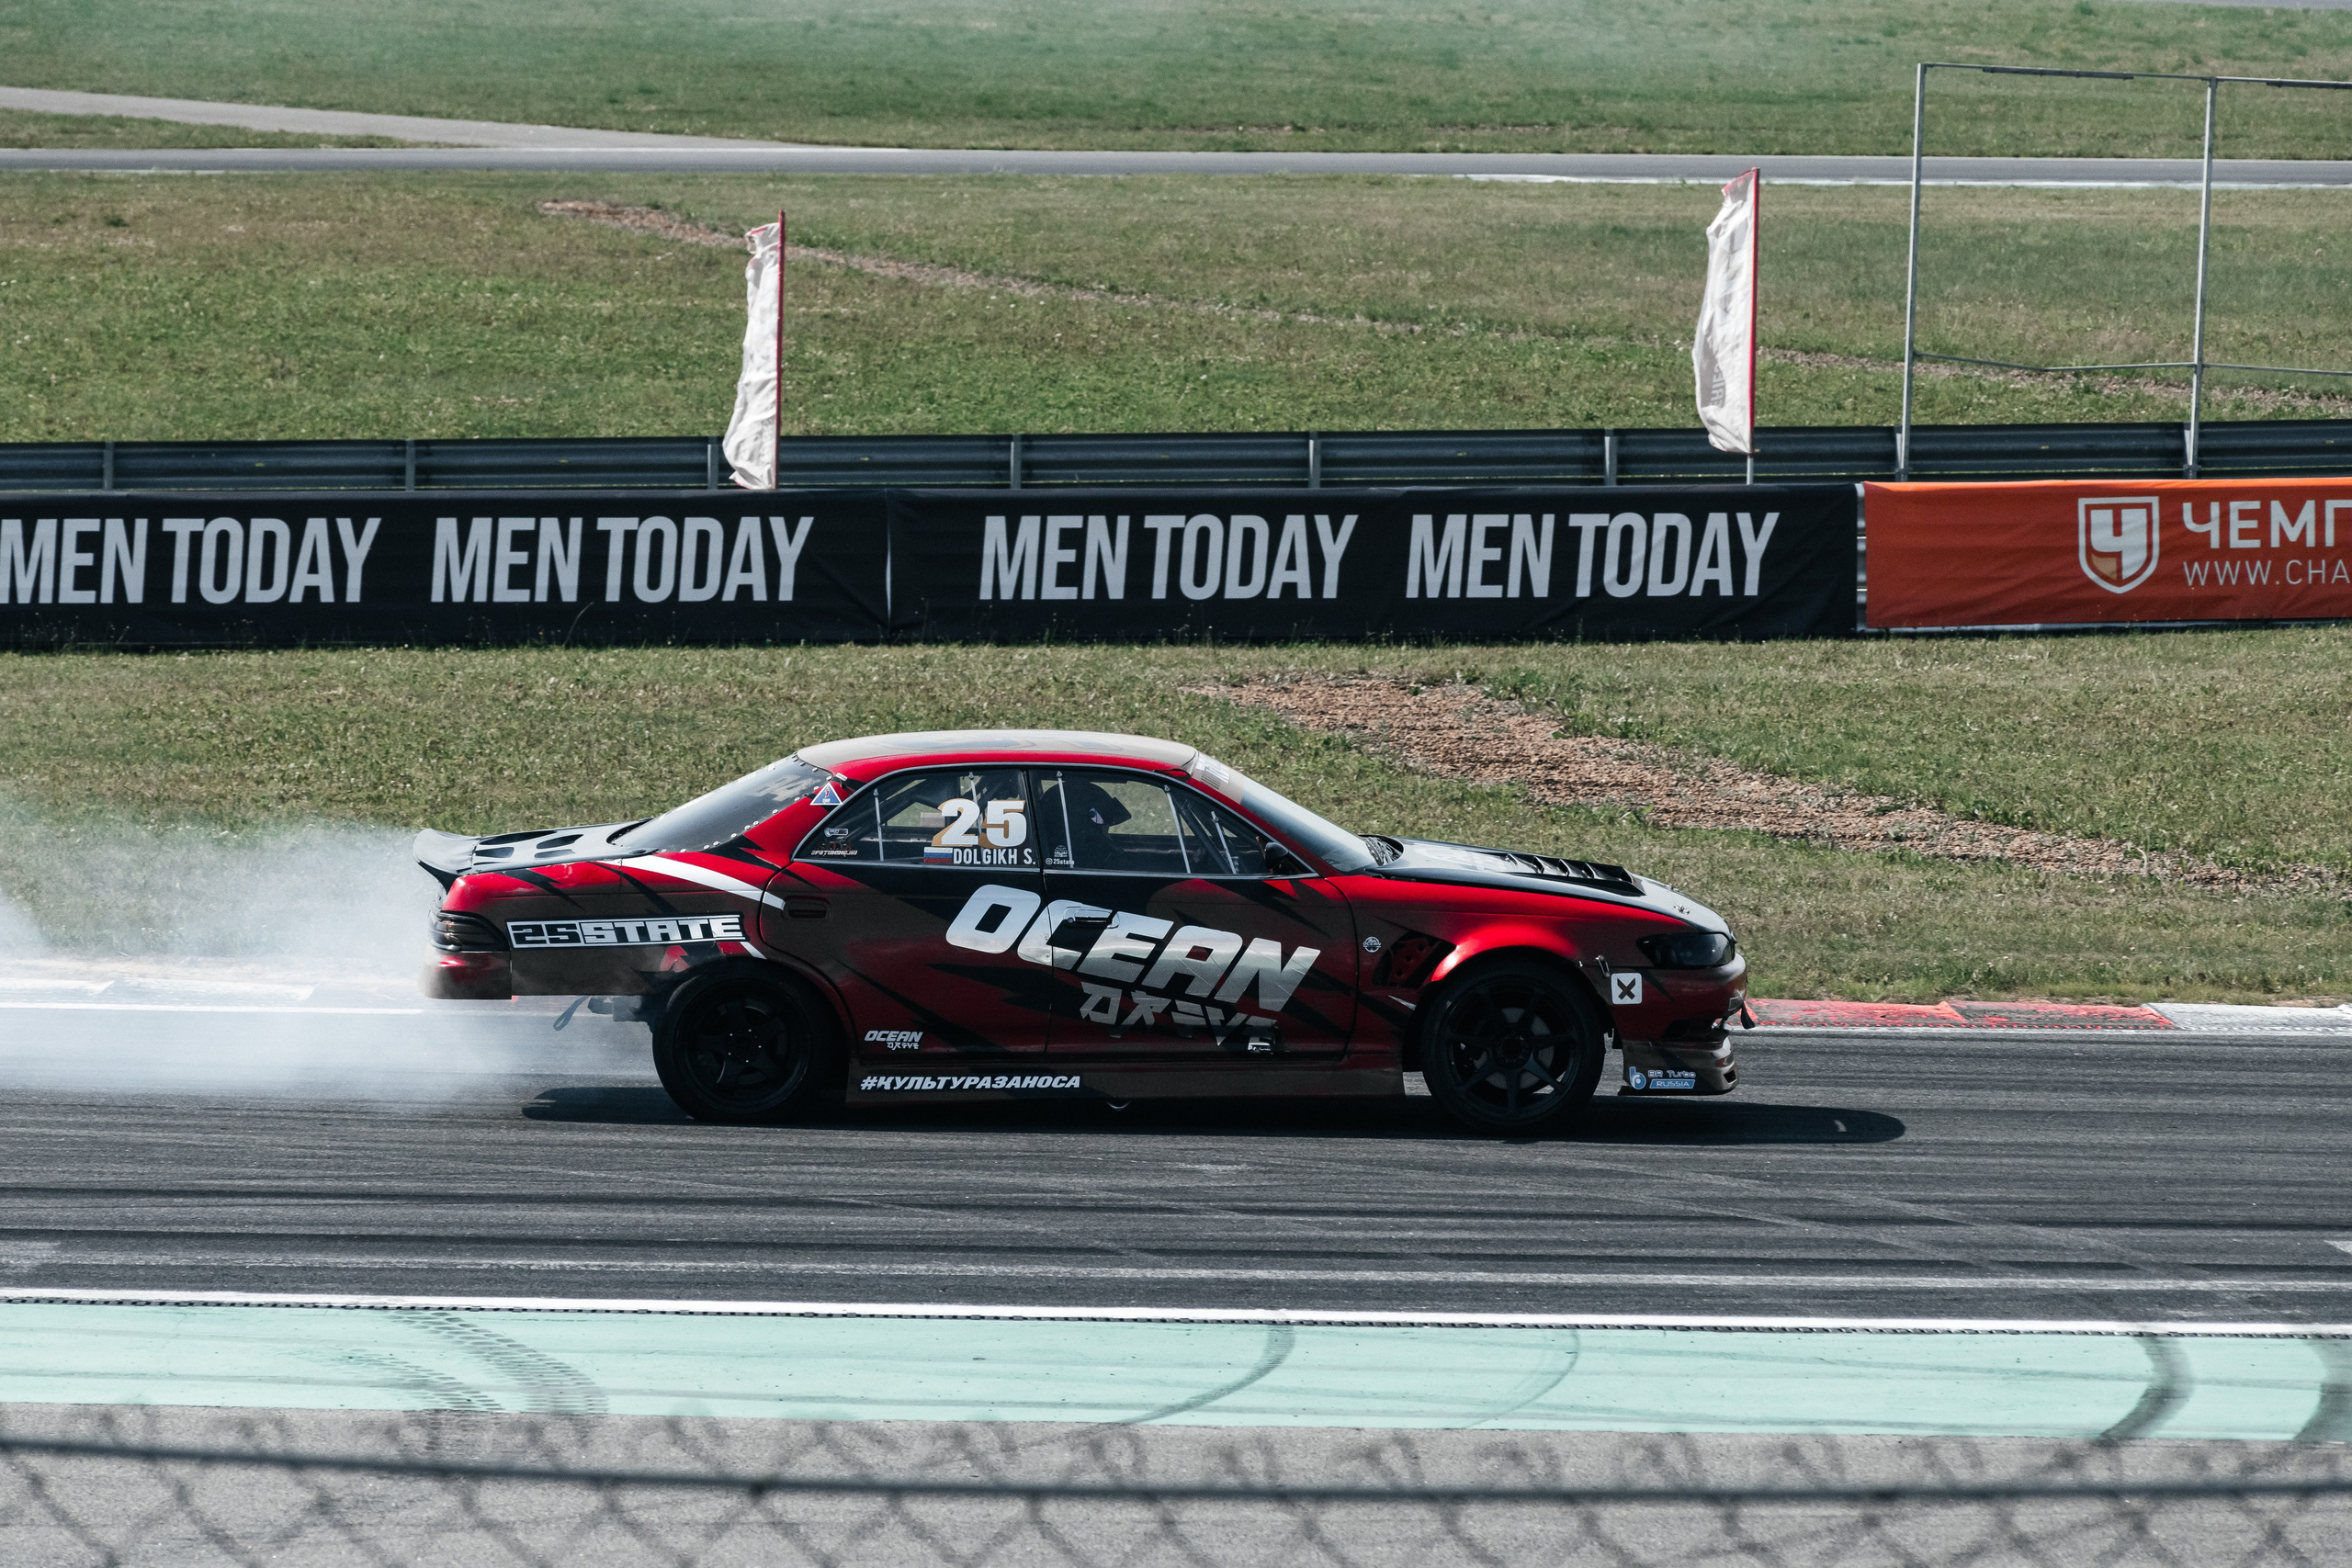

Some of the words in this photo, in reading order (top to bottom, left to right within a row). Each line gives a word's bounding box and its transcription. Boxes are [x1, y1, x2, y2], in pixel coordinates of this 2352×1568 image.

[0, 518, 148, 604] MEN
[163, 517, 381, 604] TODAY
[431, 517, 583, 603] MEN
[597, 516, 814, 603] TODAY
[979, 515, 1130, 600] MEN
[1144, 514, 1359, 600] TODAY
[1407, 514, 1555, 598] MEN
[1569, 513, 1781, 597] TODAY
[2183, 559, 2350, 586] WWW.CHA
[935, 797, 1027, 848] 25
[953, 848, 1017, 865] DOLGIKH
[1023, 848, 1036, 865] S.
[510, 917, 745, 946] 25STATE
[945, 884, 1321, 1011] OCEAN
[864, 1030, 923, 1043] OCEAN
[861, 1076, 1080, 1090] #КУЛЬТУРАЗАНОСА
[1667, 1069, 1697, 1078] Turbo
